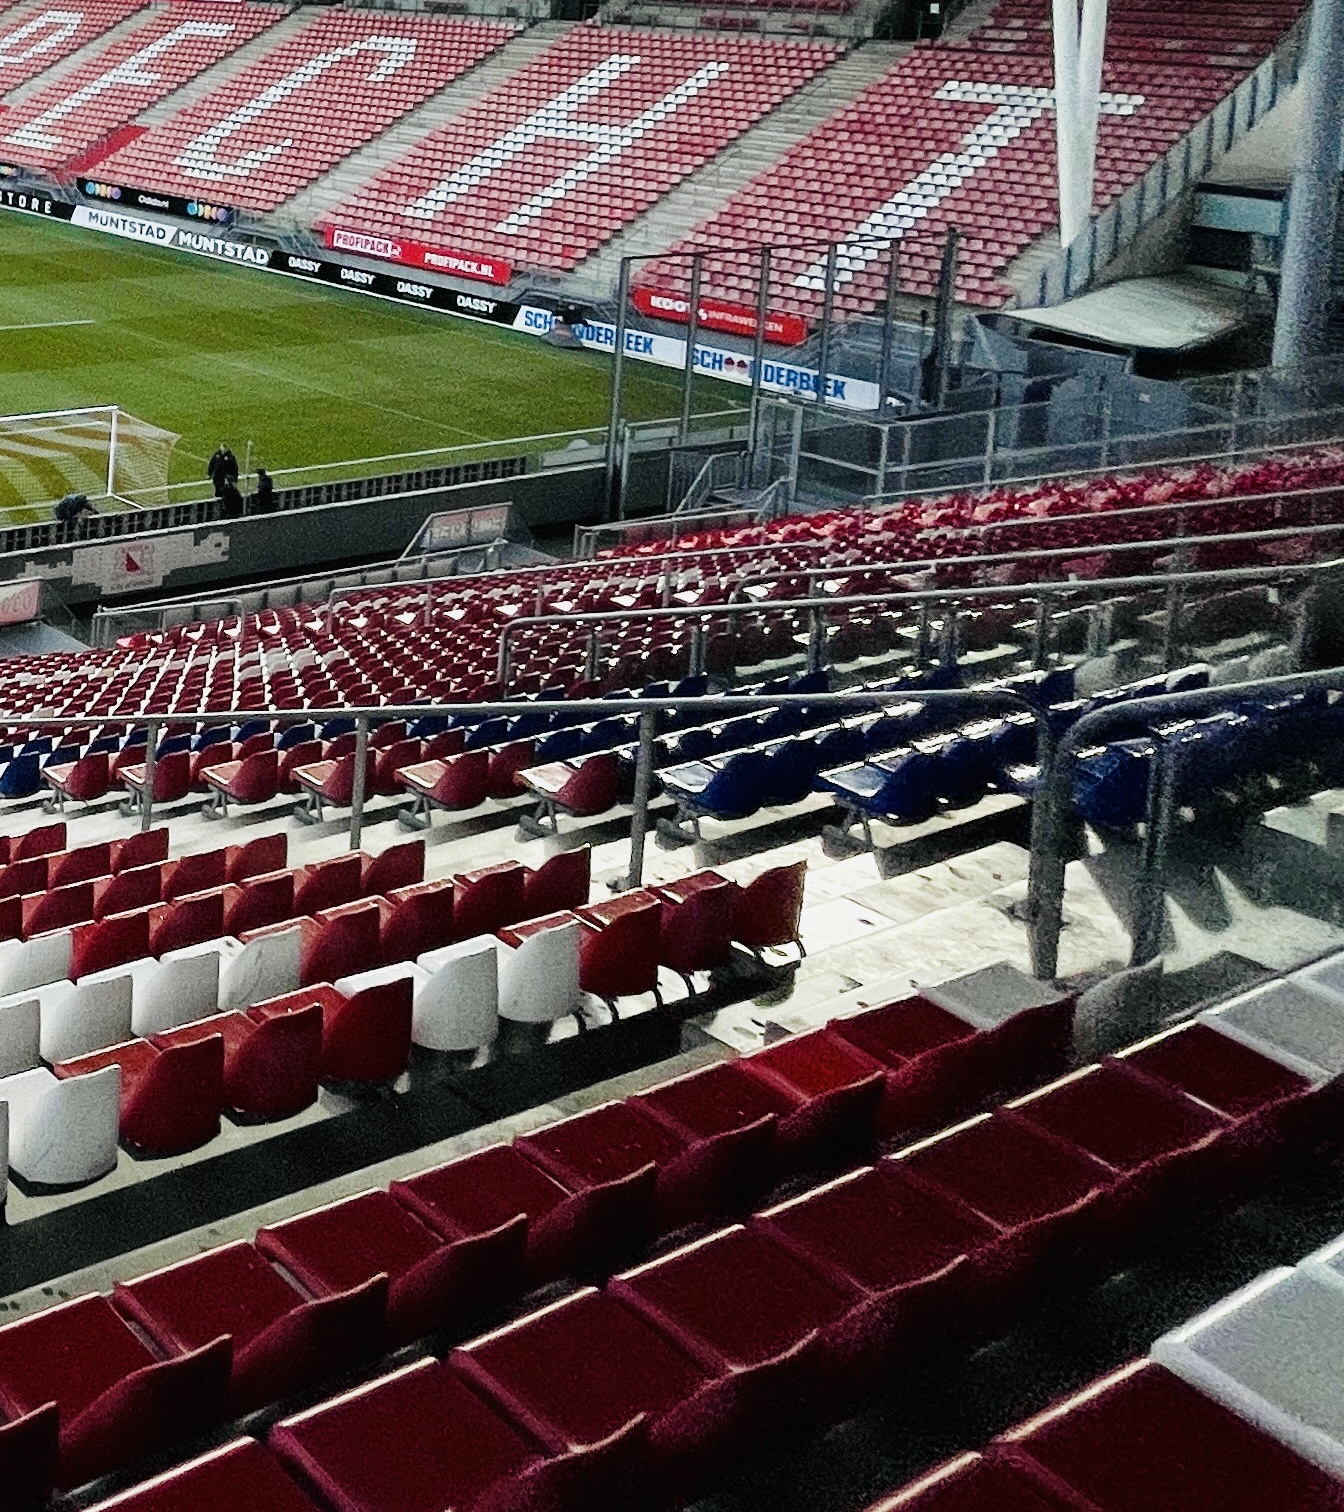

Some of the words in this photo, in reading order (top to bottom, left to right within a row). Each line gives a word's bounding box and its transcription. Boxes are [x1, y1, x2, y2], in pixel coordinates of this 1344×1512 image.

[88, 211, 167, 240] MUNTSTAD
[178, 231, 269, 265] MUNTSTAD
[335, 232, 391, 255] PROFIPACK
[288, 256, 321, 273] DASSY
[341, 268, 376, 285] DASSY
[397, 281, 434, 299] DASSY
[457, 294, 498, 314] DASSY
[524, 310, 653, 355] SCHNDEREEK
